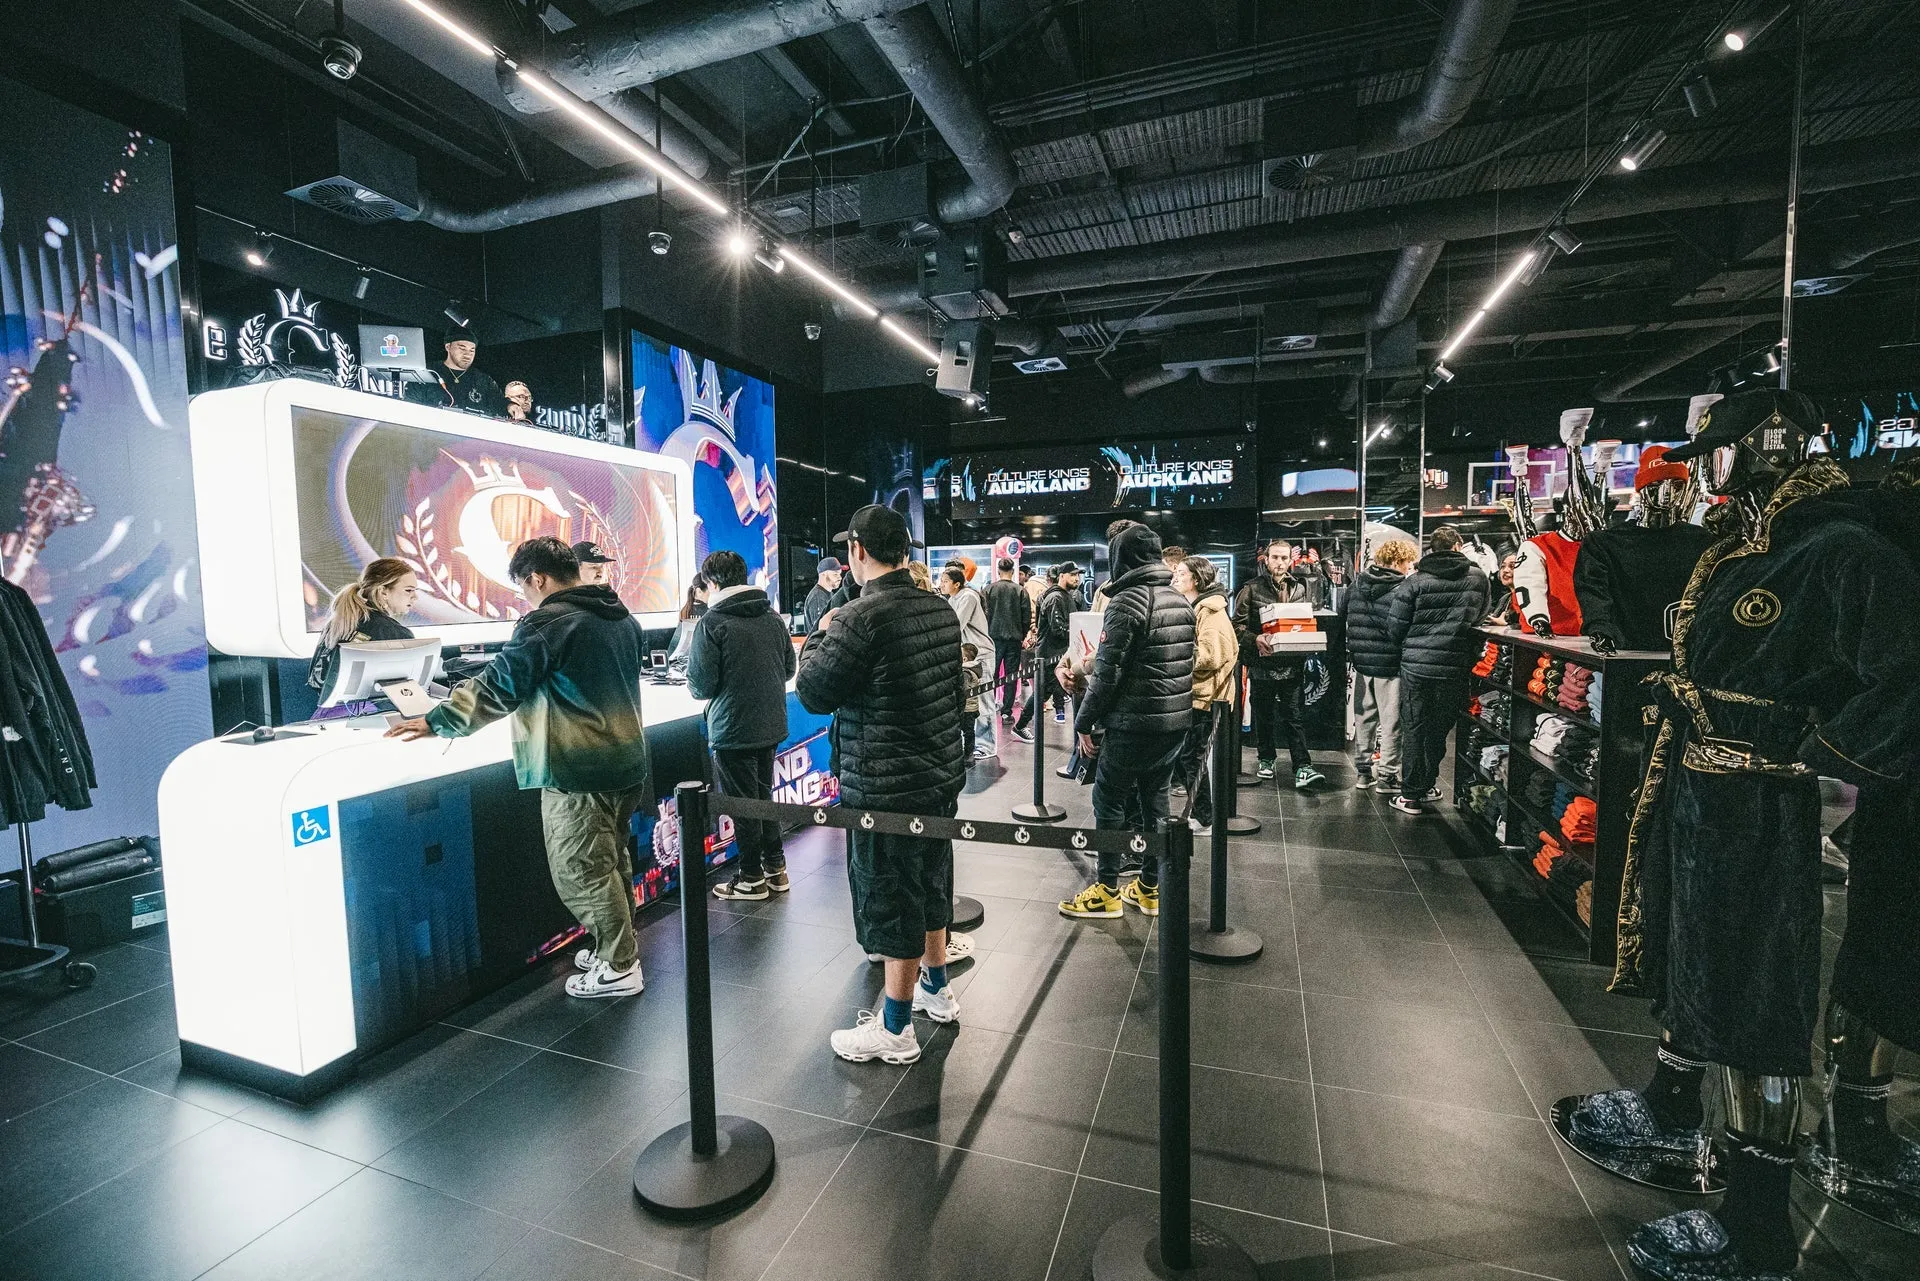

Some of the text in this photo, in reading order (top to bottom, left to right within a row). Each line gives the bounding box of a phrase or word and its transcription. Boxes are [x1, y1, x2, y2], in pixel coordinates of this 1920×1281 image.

[988, 468, 1090, 482] CULTURE KINGS
[1120, 459, 1233, 475] CULTURE KINGS
[987, 478, 1091, 495] AUCKLAND
[1120, 470, 1233, 488] AUCKLAND
[773, 746, 809, 788] ND
